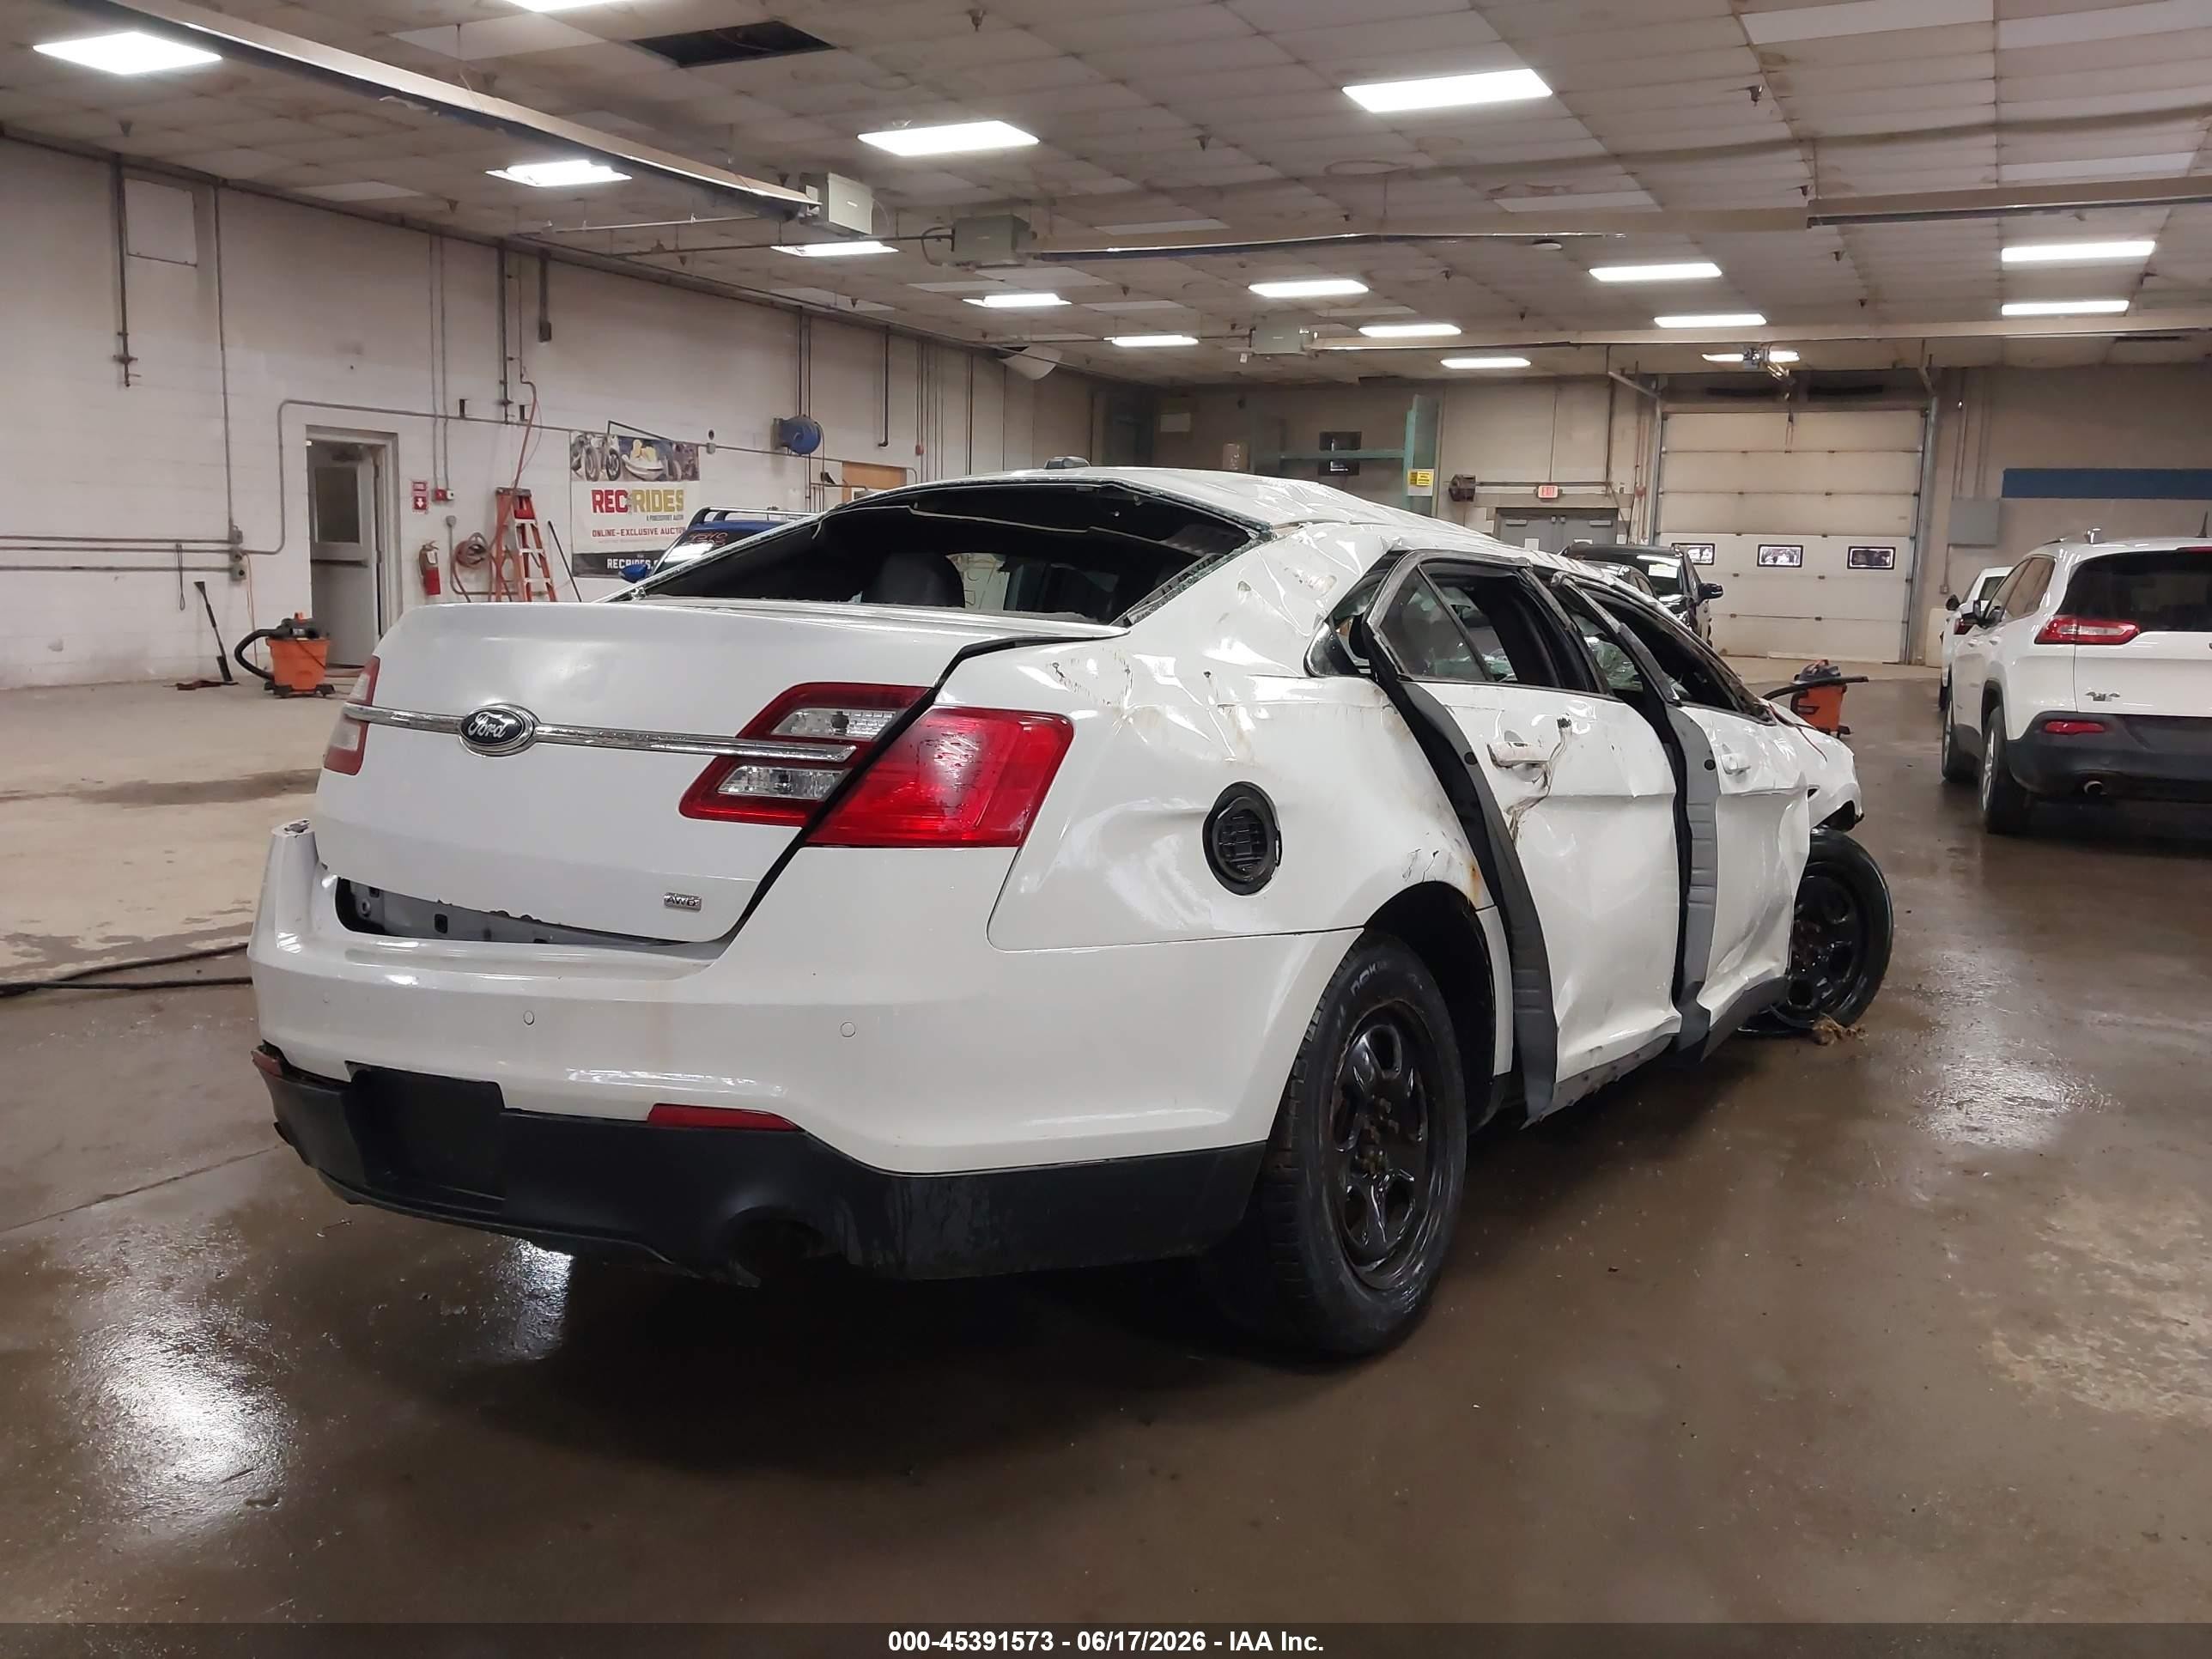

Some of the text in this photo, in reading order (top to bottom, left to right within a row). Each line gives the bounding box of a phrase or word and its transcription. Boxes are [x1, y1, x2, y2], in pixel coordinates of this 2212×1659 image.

[591, 489, 629, 514] REC
[631, 489, 684, 513] RIDES
[592, 527, 659, 538] ONLINE-EXCLUSIVE
[468, 712, 516, 738] Ford
